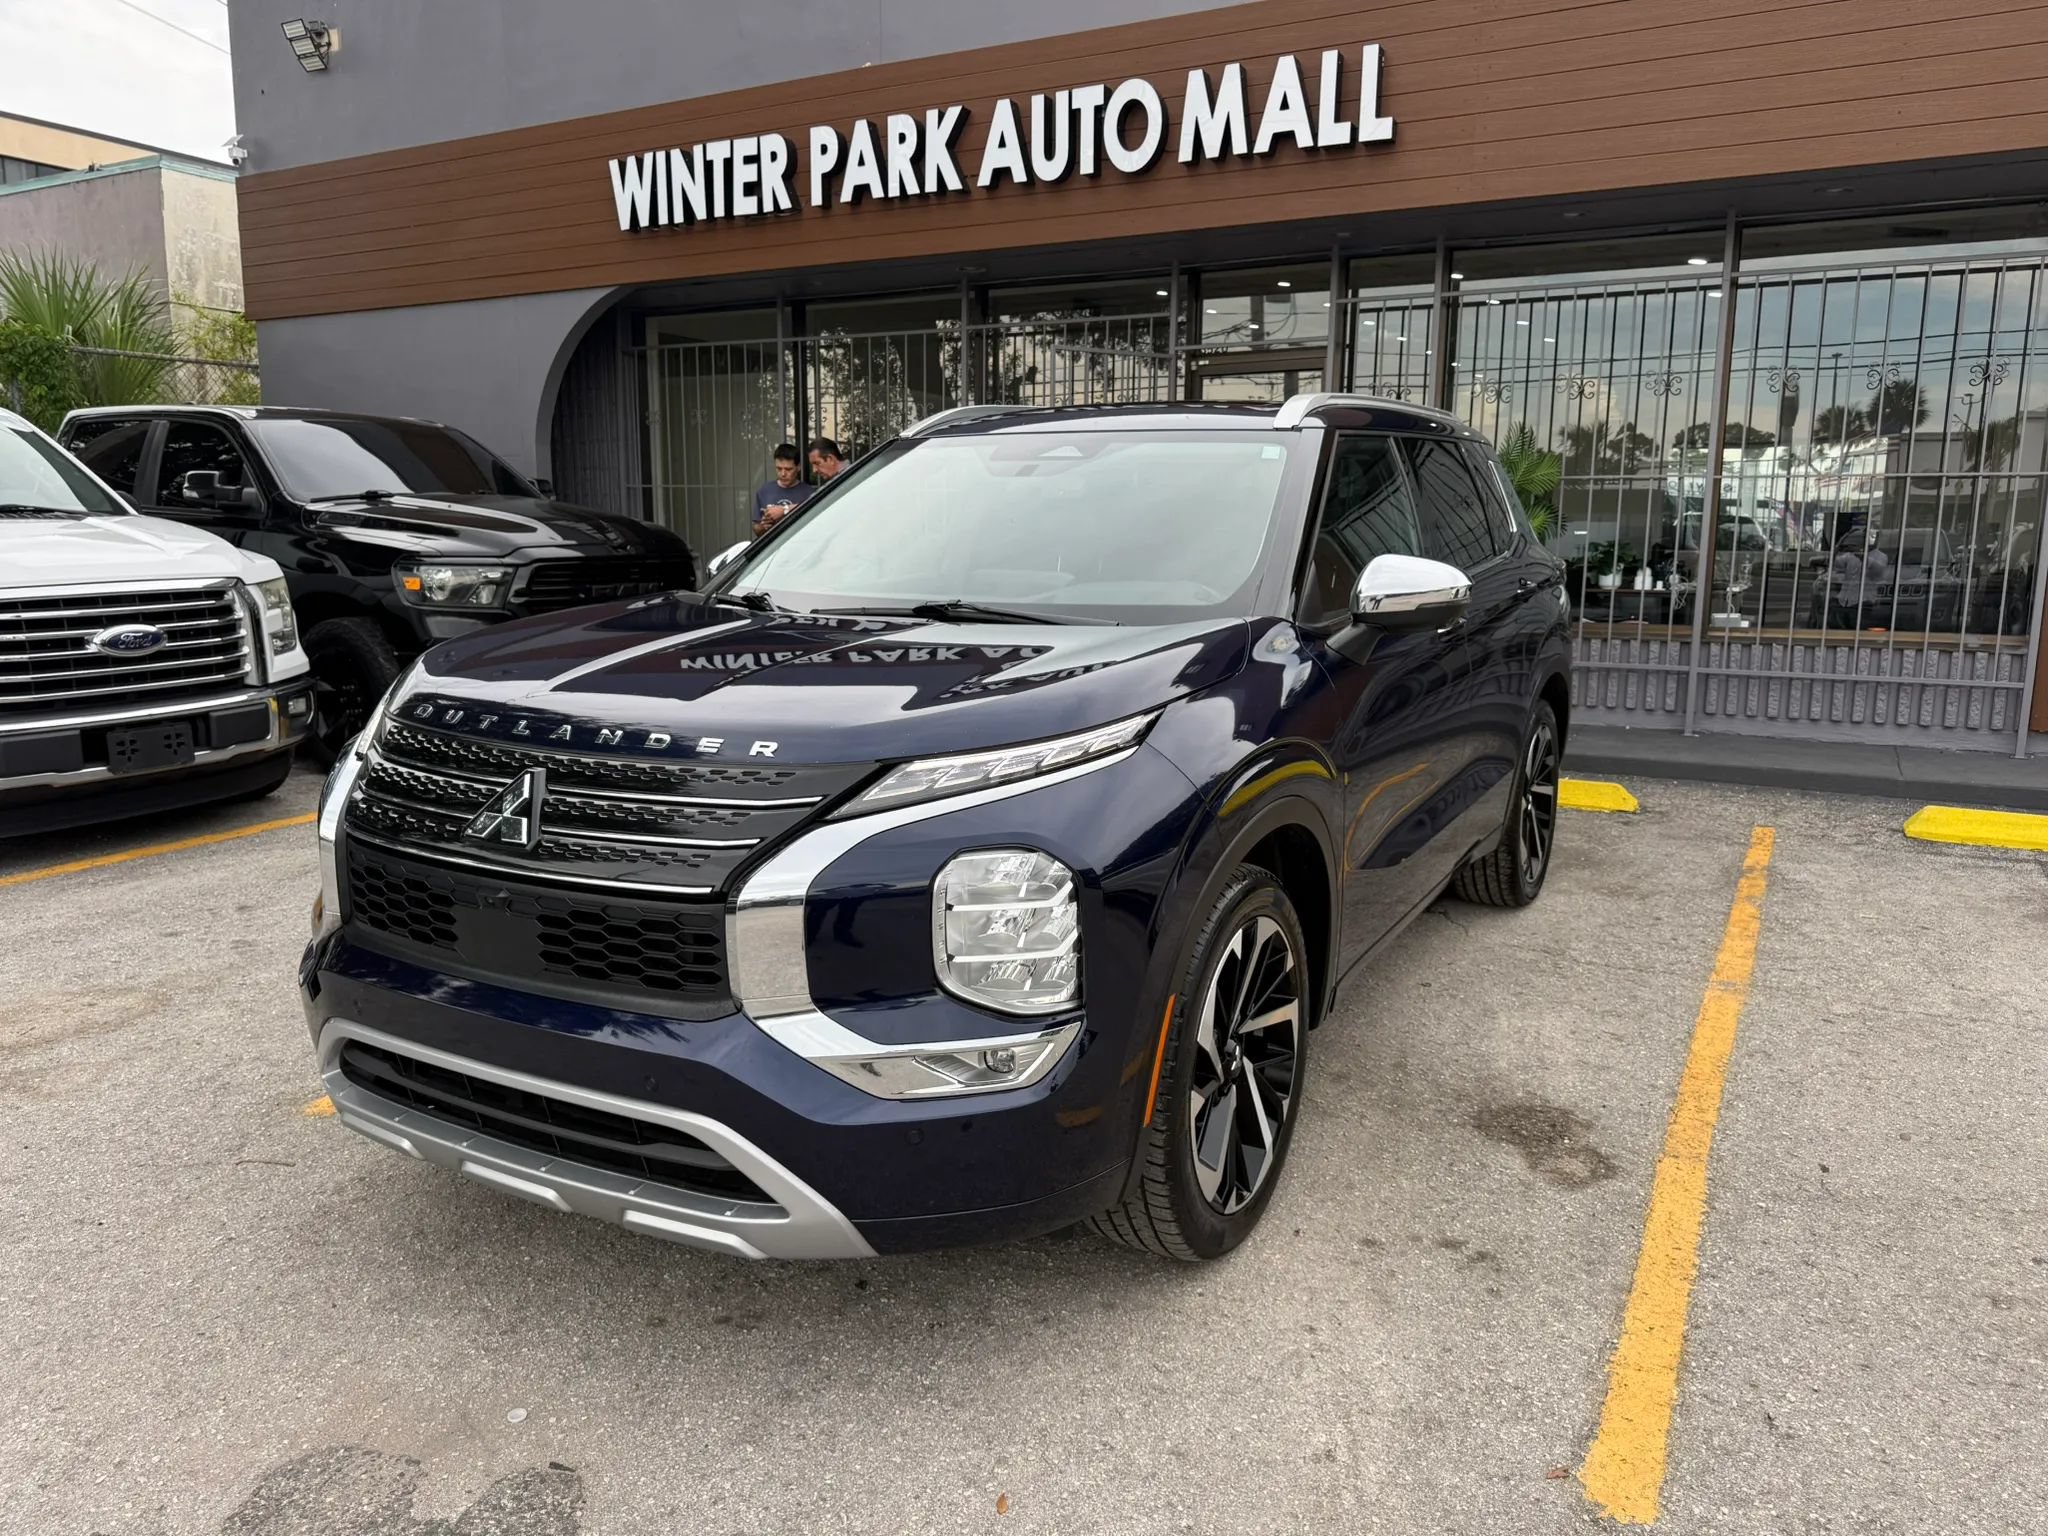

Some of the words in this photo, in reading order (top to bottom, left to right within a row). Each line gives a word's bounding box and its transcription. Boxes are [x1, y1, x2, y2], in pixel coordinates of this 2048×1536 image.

[609, 133, 793, 231] WINTER
[810, 105, 963, 207] PARK
[977, 78, 1163, 187] AUTO
[1177, 43, 1393, 163] MALL
[118, 632, 153, 649] Ford
[413, 703, 779, 759] OUTLANDER
